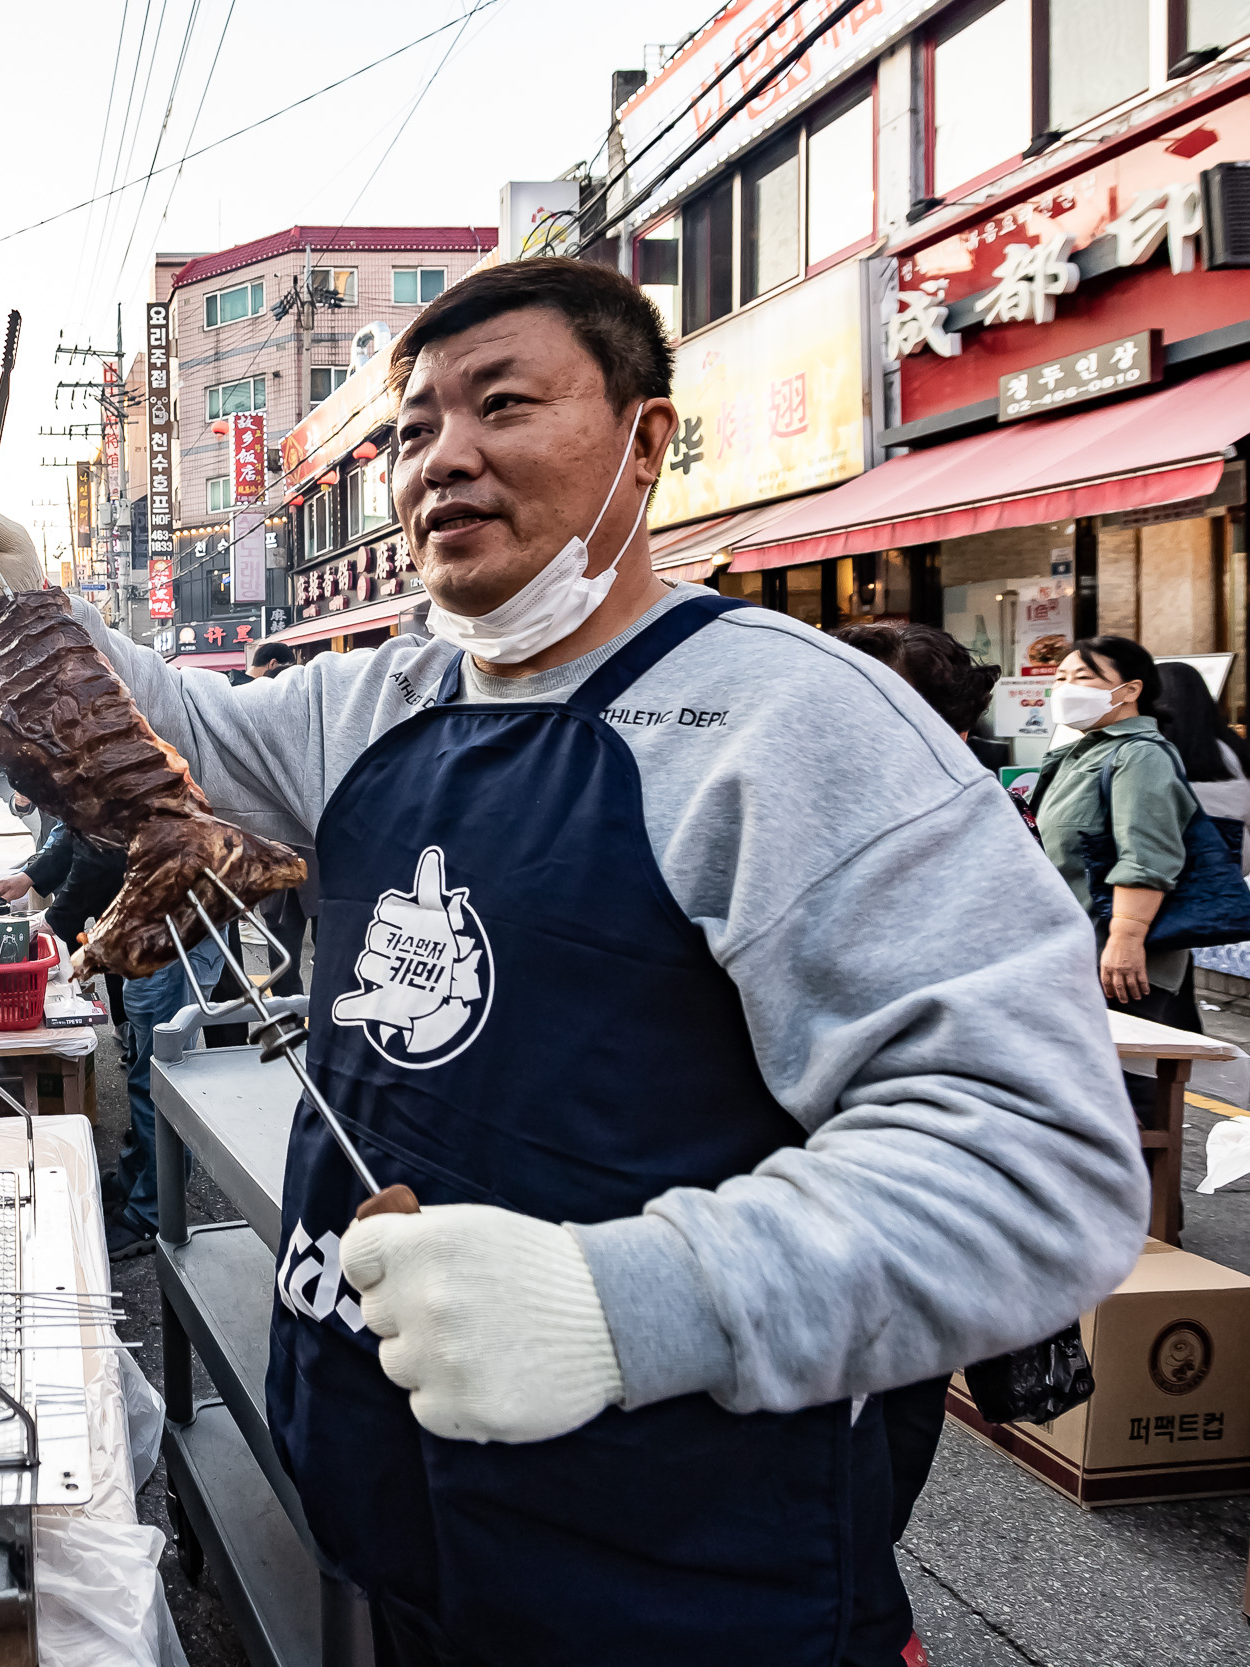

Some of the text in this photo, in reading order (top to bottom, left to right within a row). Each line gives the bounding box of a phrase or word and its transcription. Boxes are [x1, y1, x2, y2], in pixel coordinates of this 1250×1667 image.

[149, 306, 167, 389] 요리주점
[1006, 340, 1139, 400] 청두인상
[235, 415, 259, 483] 故乡饭店
[150, 432, 170, 513] 천수호프
[150, 529, 173, 541] 463-
[151, 513, 172, 526] HOF
[150, 540, 173, 552] 1833
[602, 708, 674, 727] THLETIC
[386, 931, 448, 961] 카스먼저
[389, 956, 447, 993] 카먼!
[1128, 1411, 1225, 1446] 퍼팩트컵
